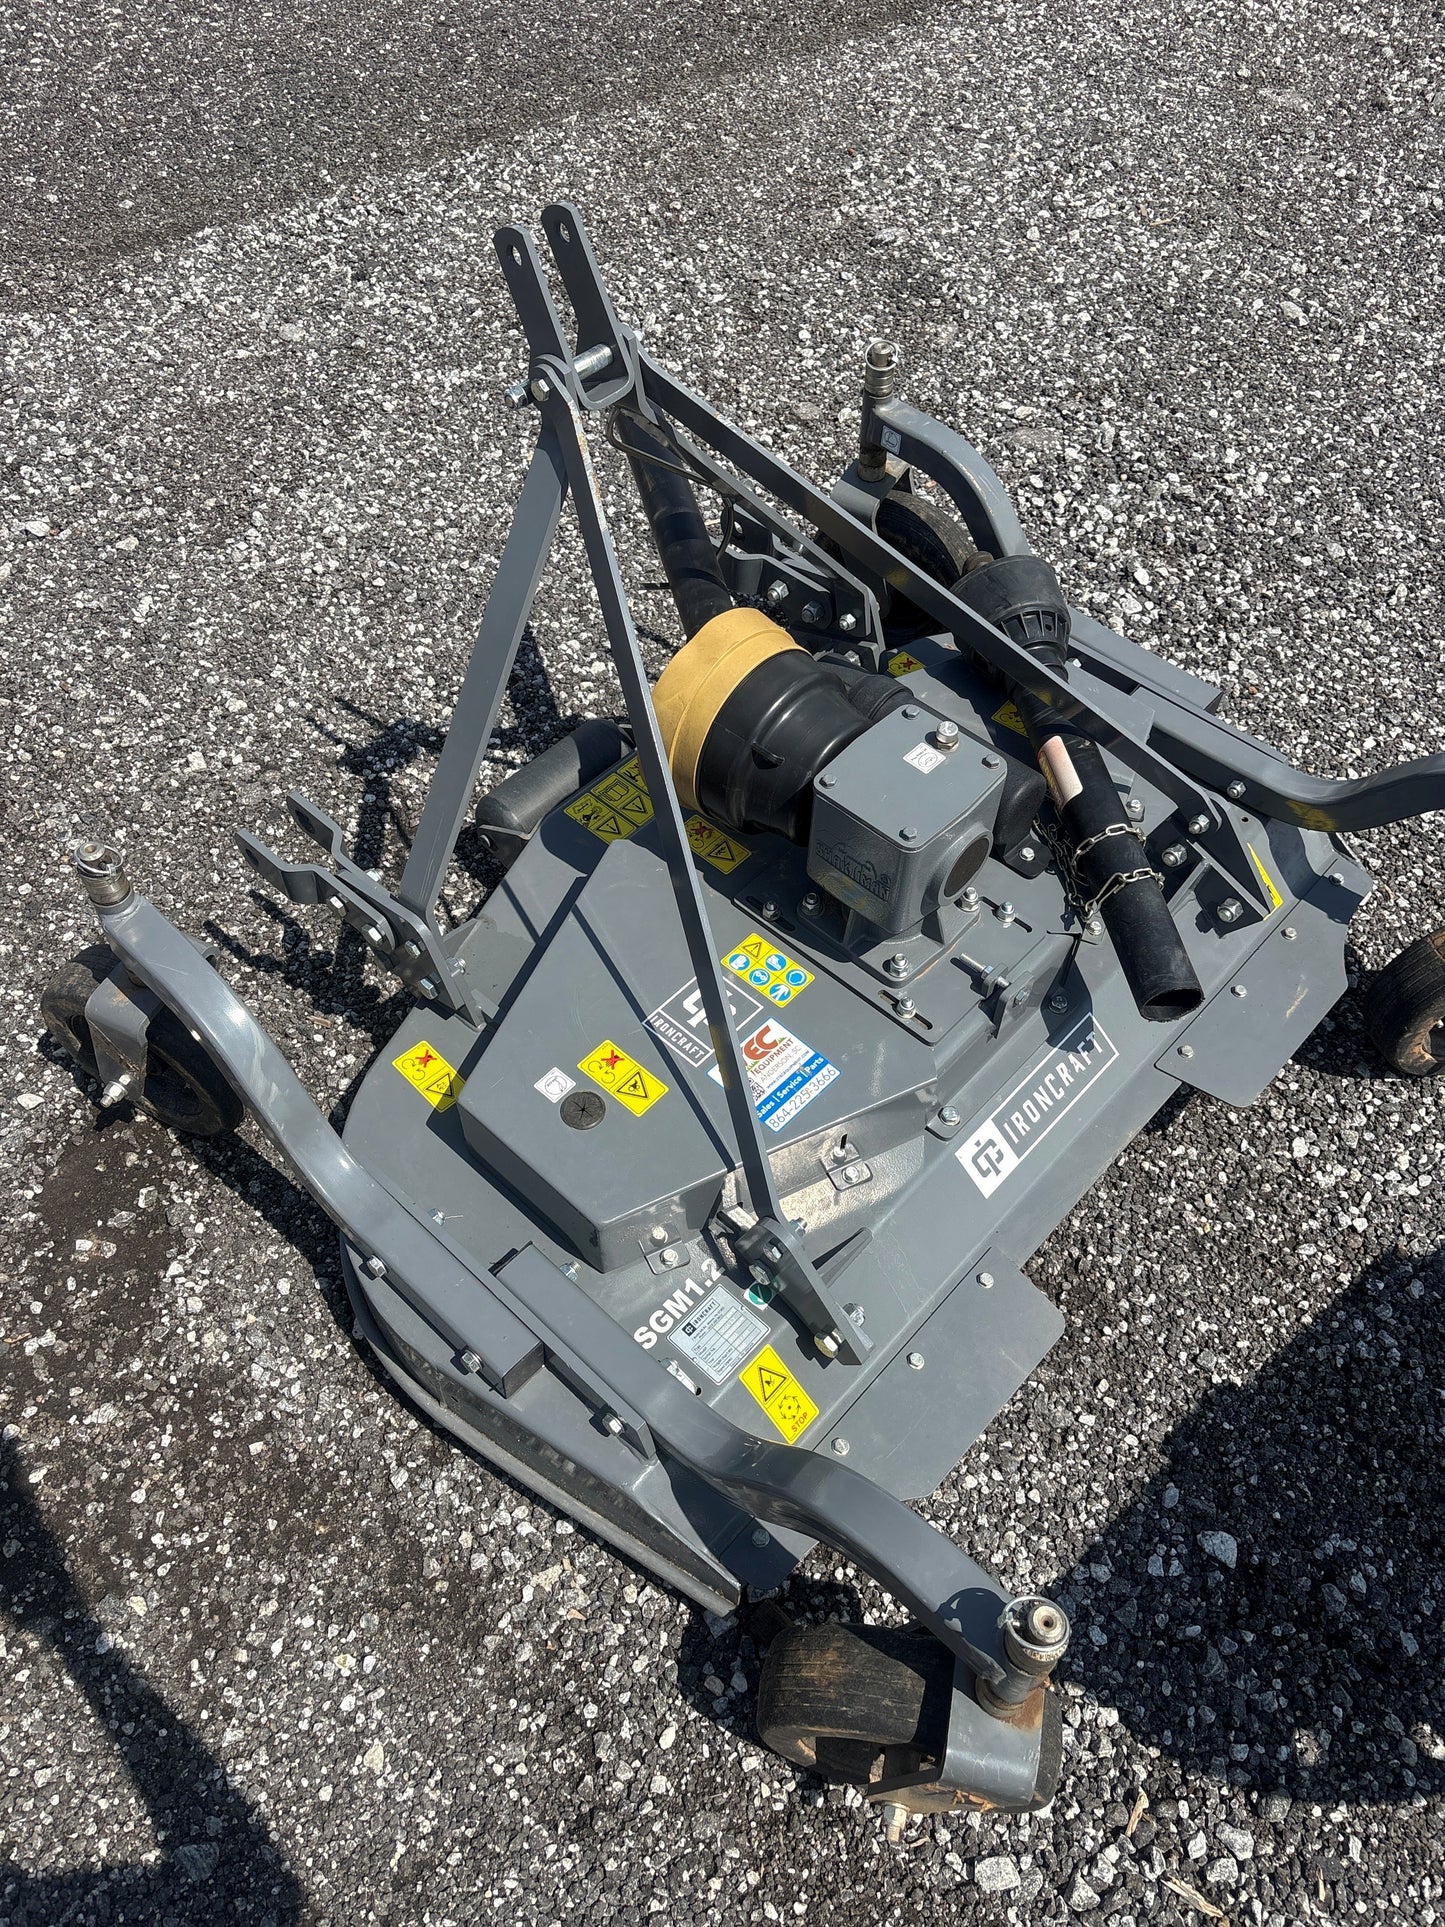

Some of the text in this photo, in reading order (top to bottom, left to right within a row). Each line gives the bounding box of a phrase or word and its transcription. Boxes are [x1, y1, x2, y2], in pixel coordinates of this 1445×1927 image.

[649, 1015, 705, 1059] IRONCRAFT
[755, 1038, 794, 1075] EQUIPMENT
[791, 1045, 802, 1055] SC
[757, 1100, 775, 1118] Sales
[776, 1076, 803, 1099] Service
[804, 1056, 825, 1074] Parts
[768, 1067, 837, 1128] 864-225-3666
[1003, 1031, 1103, 1144] IRONCRAFT
[633, 1258, 723, 1350] SGM1.2
[693, 1301, 716, 1325] IRONCRAFT
[791, 1412, 809, 1432] STOP
